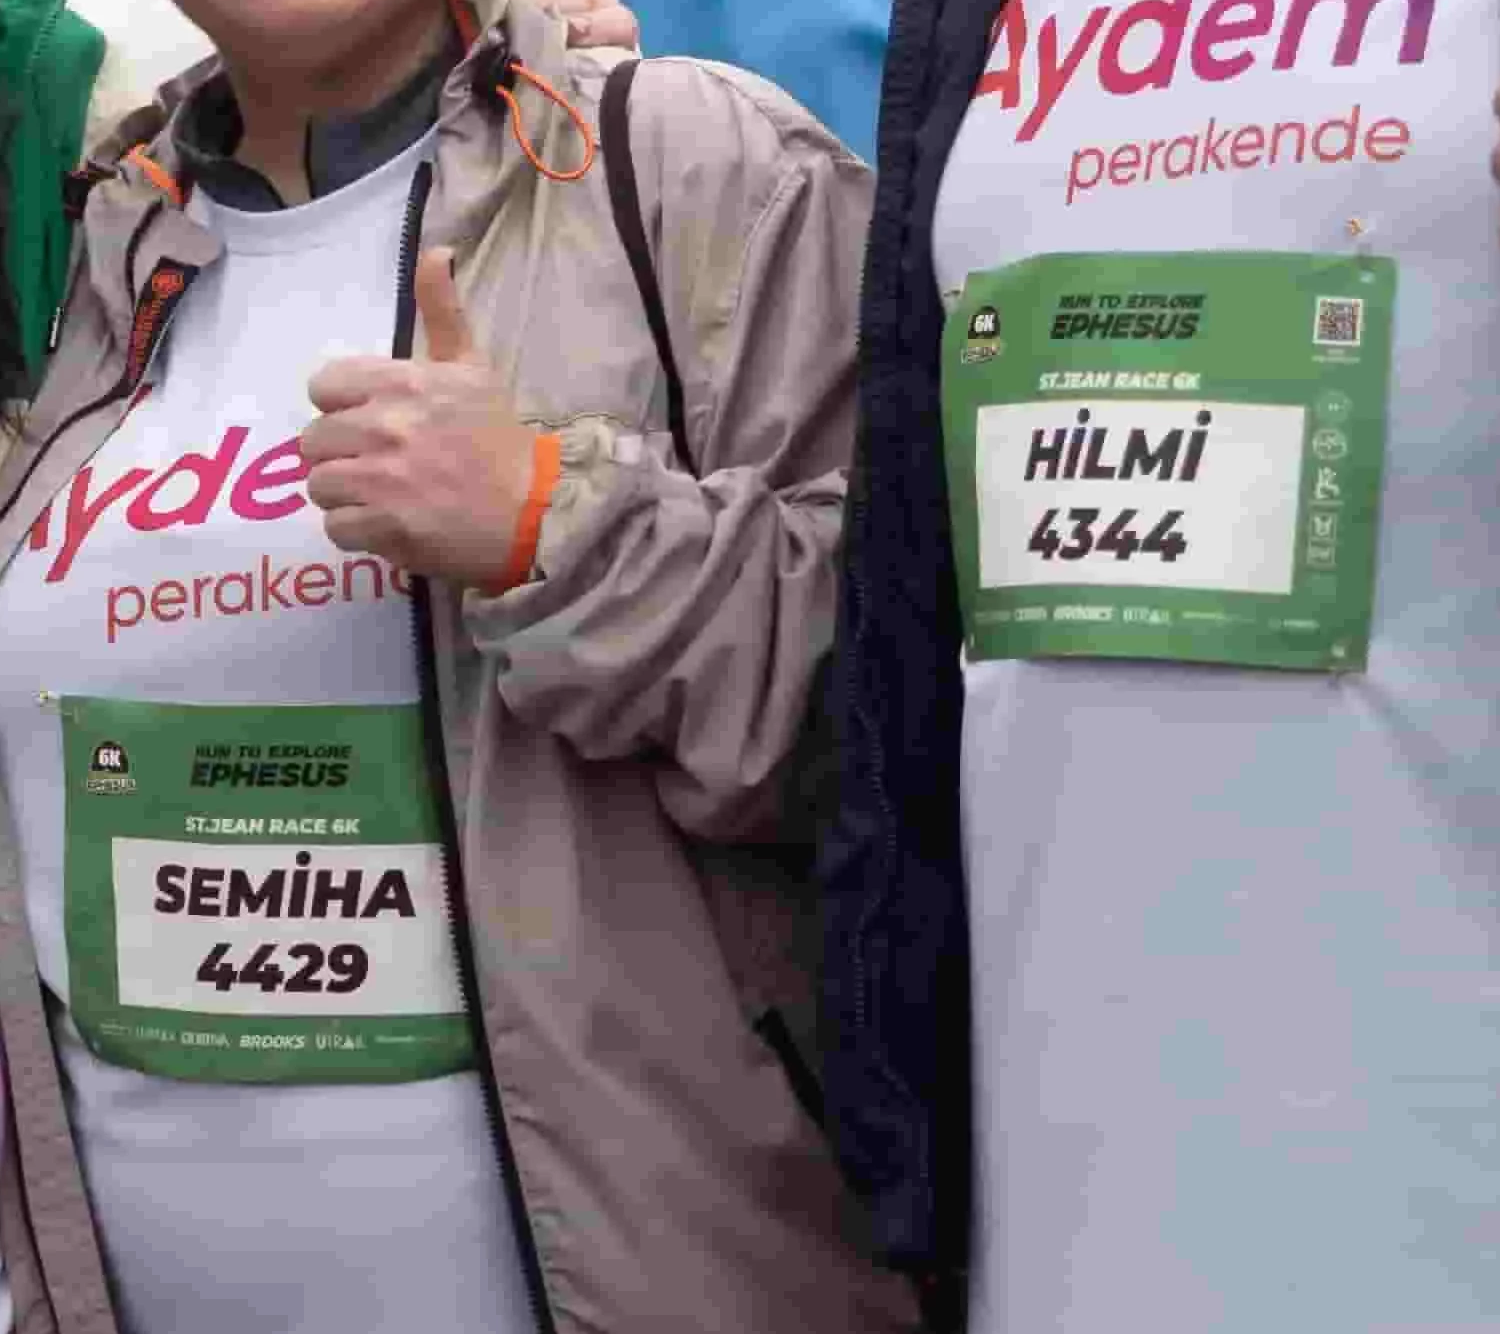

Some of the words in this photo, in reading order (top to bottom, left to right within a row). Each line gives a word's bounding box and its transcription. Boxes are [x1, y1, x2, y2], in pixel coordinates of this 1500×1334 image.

[1065, 105, 1411, 205] perakende
[1099, 294, 1121, 309] TO
[1050, 313, 1200, 340] EPHESUS
[1114, 372, 1170, 390] RACE
[1024, 407, 1212, 482] HİLMİ
[1027, 508, 1187, 562] 4344
[99, 748, 122, 767] 6K
[195, 745, 231, 758] RUN
[239, 745, 261, 758] TO
[268, 745, 353, 759] EXPLORE
[190, 762, 349, 788] EPHESUS
[268, 818, 327, 835] RACE
[331, 818, 360, 835] 6K
[153, 850, 417, 919] SEMİHA
[196, 942, 370, 994] 4429
[240, 1034, 305, 1049] BROOKS
